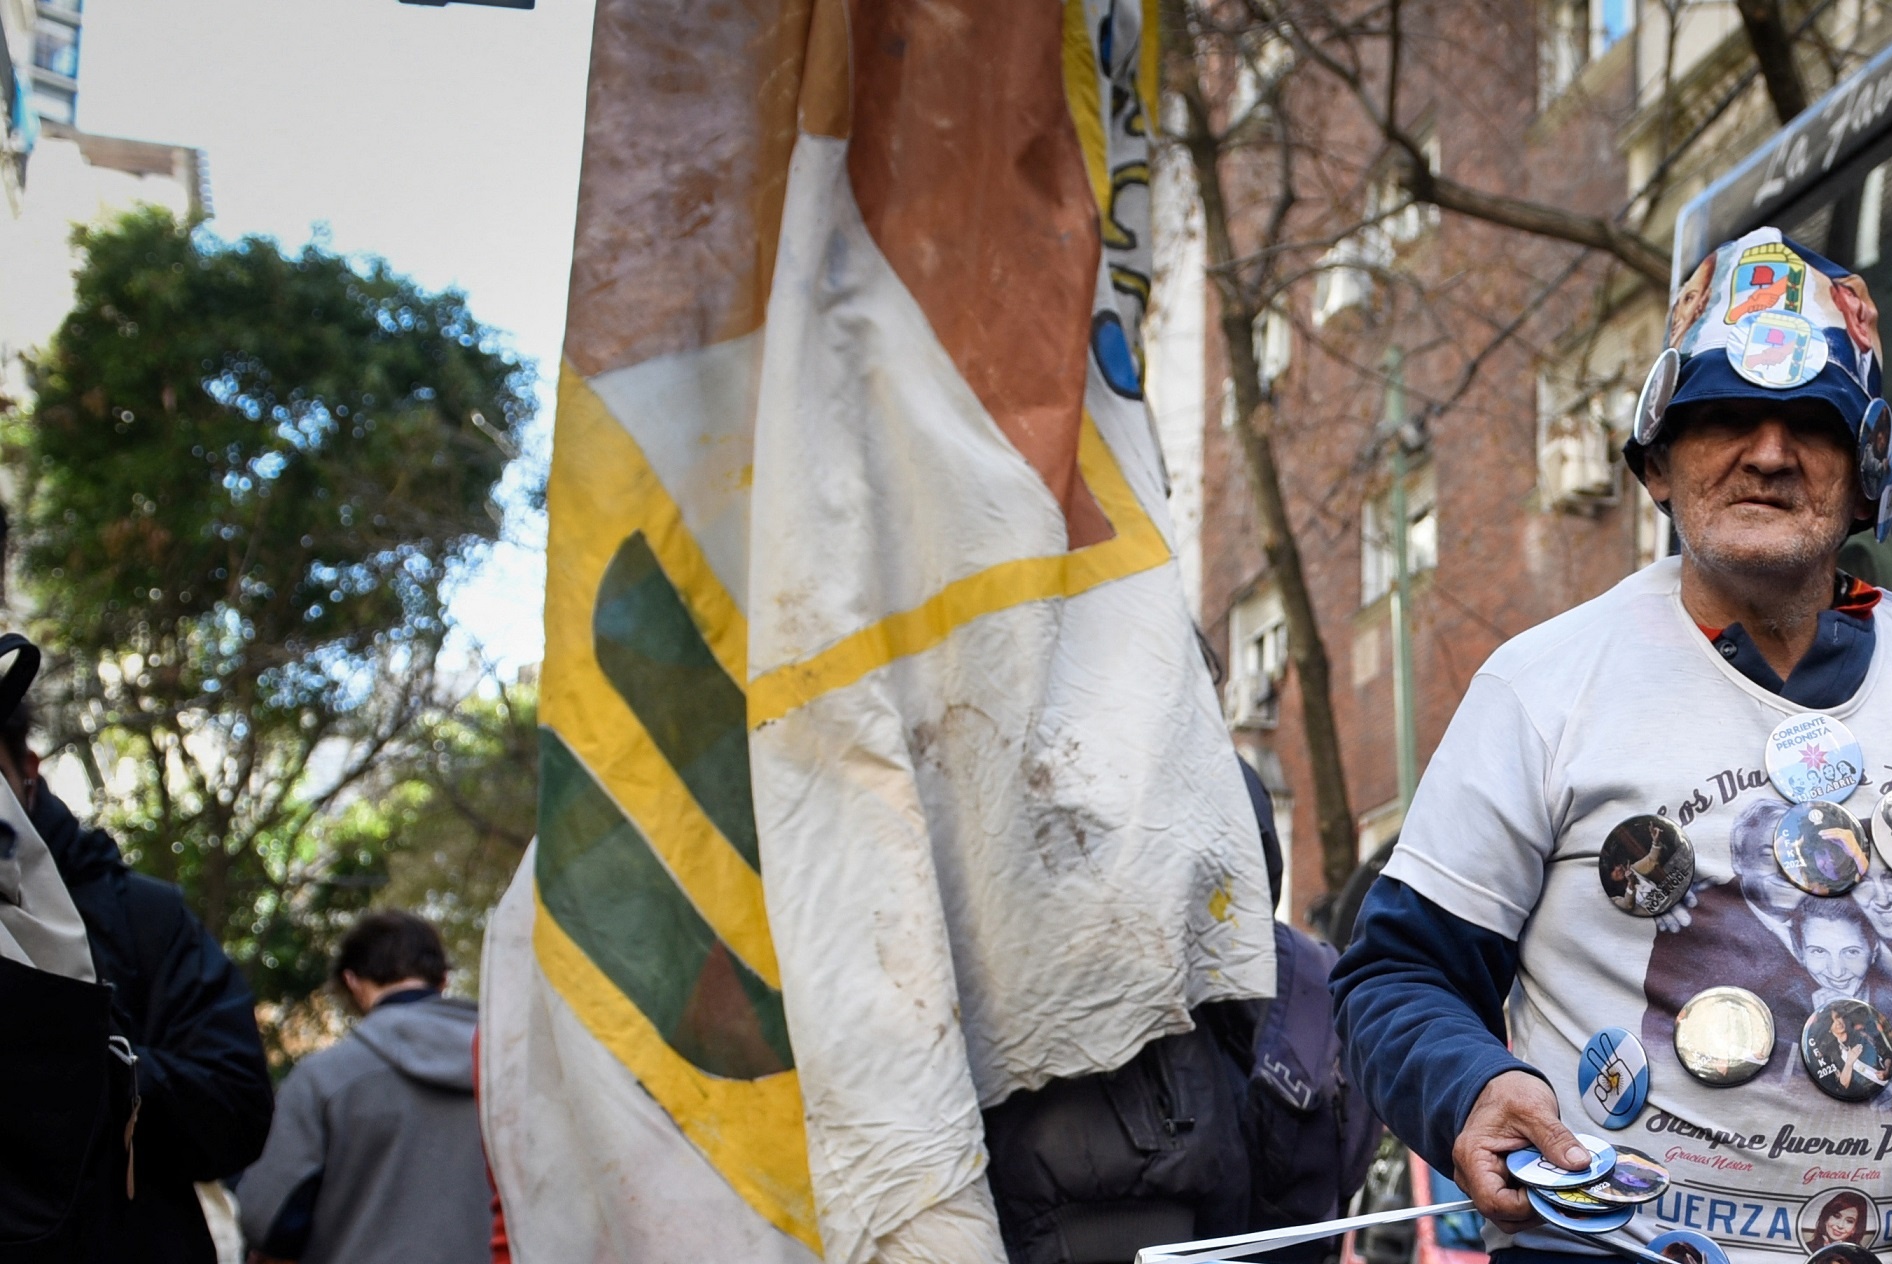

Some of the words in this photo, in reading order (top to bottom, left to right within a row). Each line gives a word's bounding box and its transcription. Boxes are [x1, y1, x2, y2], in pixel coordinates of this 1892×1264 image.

[1772, 716, 1827, 742] CORRIENTE
[1775, 727, 1832, 752] PERONISTA
[1825, 774, 1856, 794] ABRIL
[1817, 1063, 1838, 1080] 2023
[1768, 1123, 1873, 1158] fueron
[1802, 1165, 1850, 1185] Gracias
[1849, 1166, 1882, 1182] Evita
